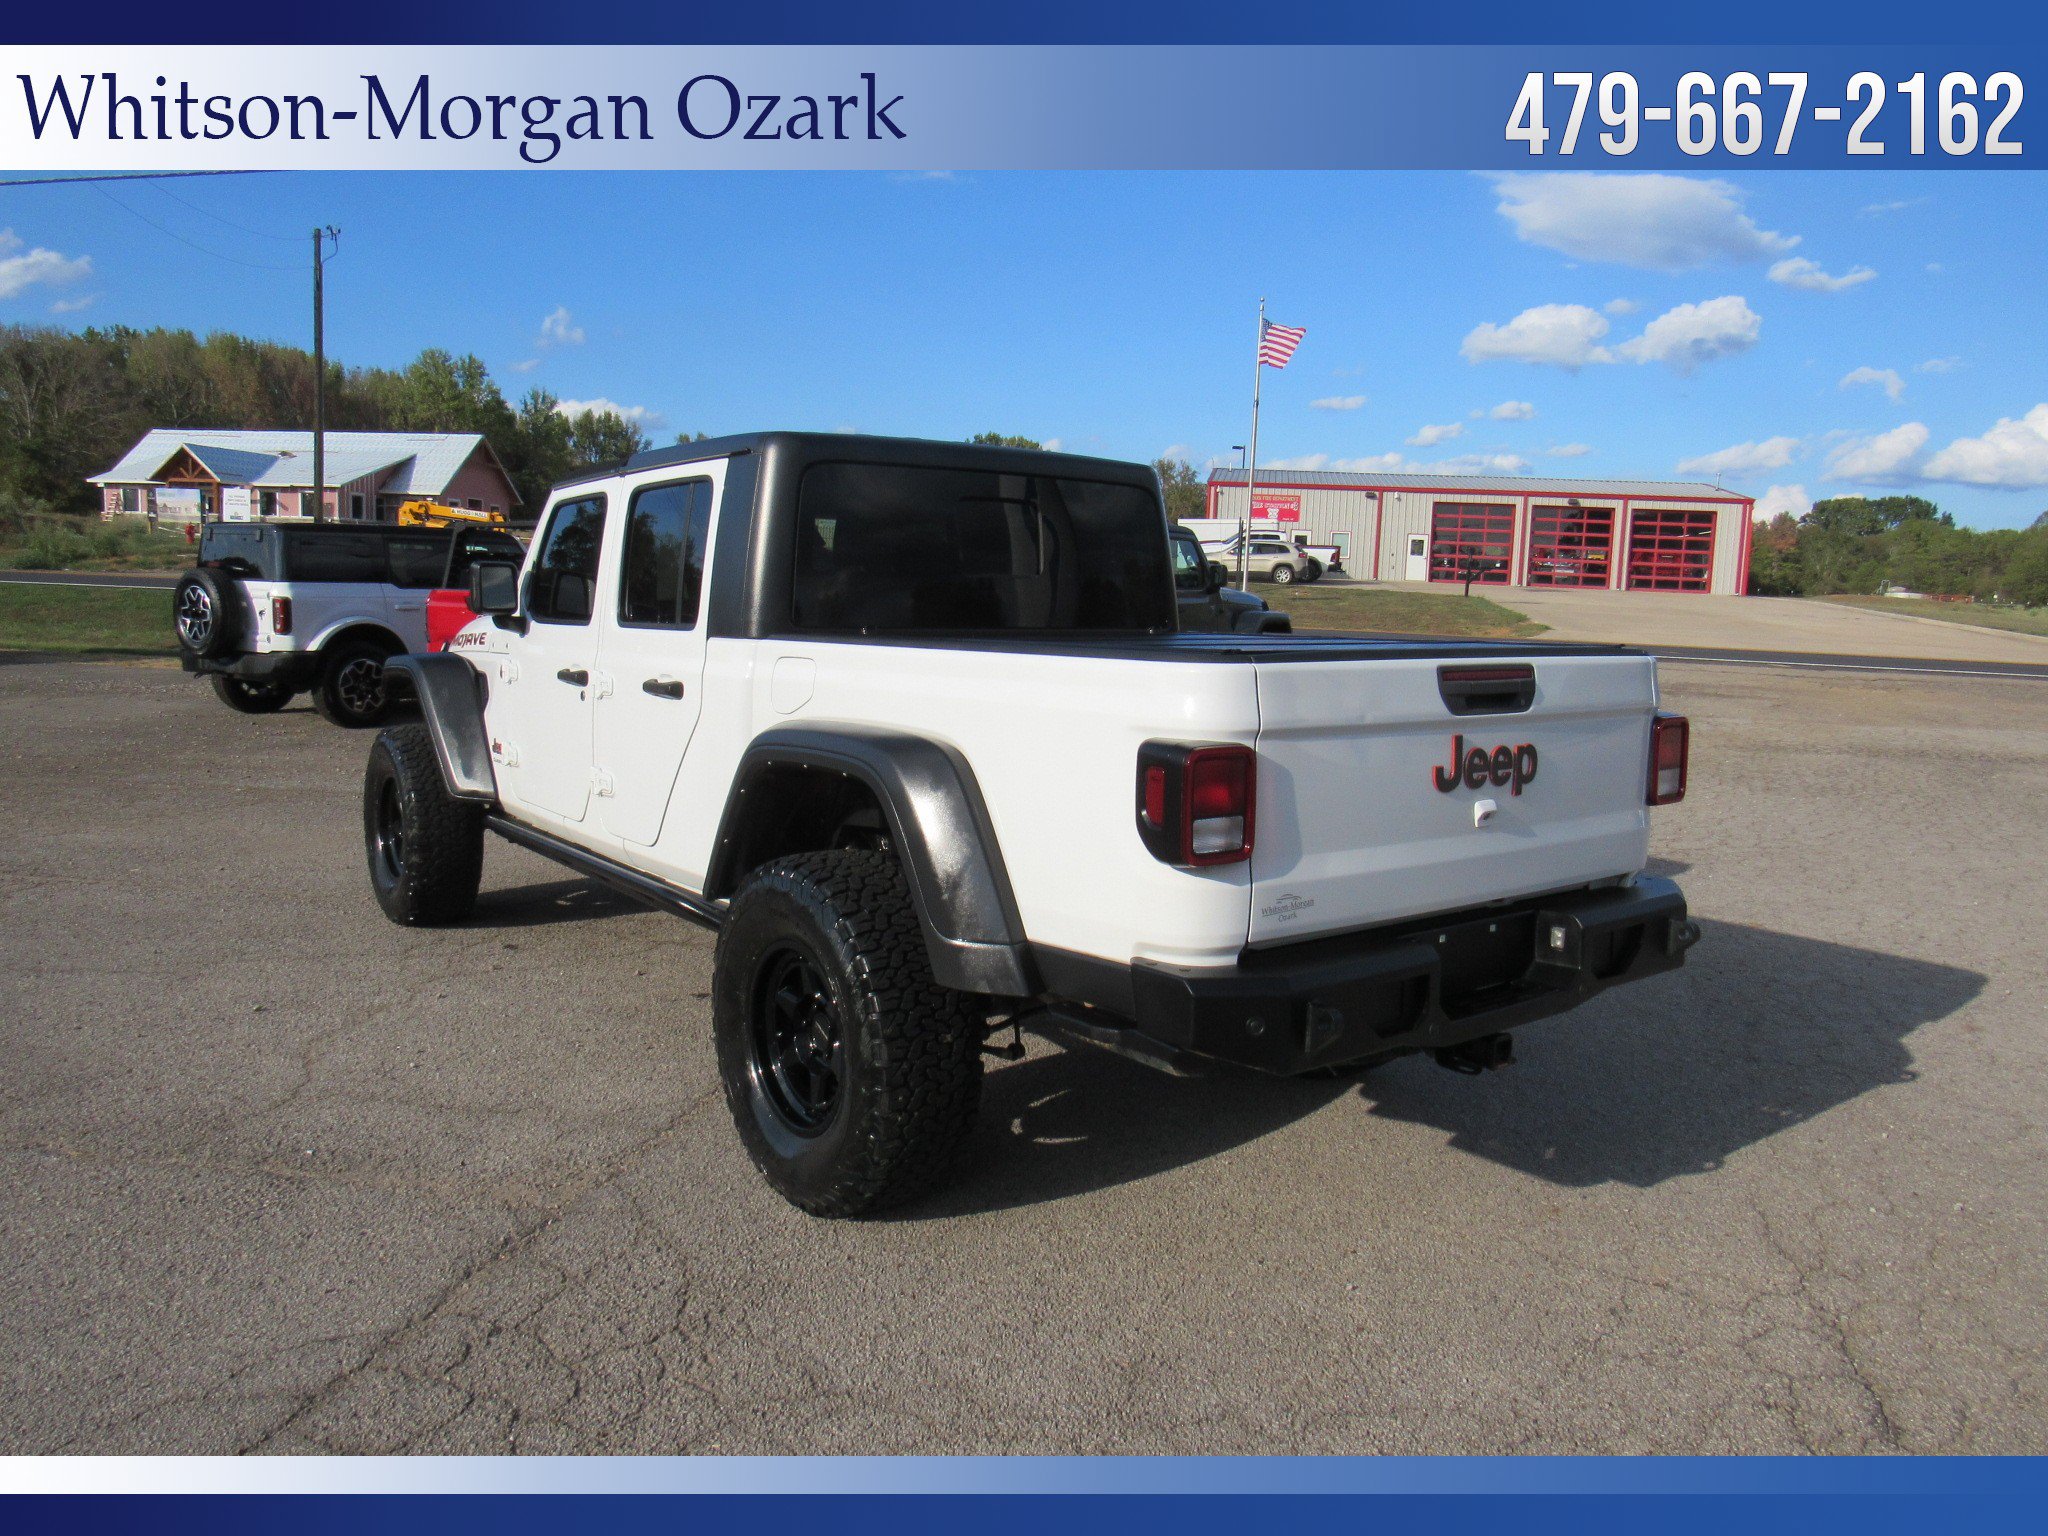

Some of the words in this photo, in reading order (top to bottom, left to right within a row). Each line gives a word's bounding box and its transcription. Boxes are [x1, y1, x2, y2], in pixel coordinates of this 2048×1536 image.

[451, 632, 487, 648] MOJAVE
[1431, 733, 1538, 797] Jeep
[1261, 899, 1315, 916] Whitson-Morgan
